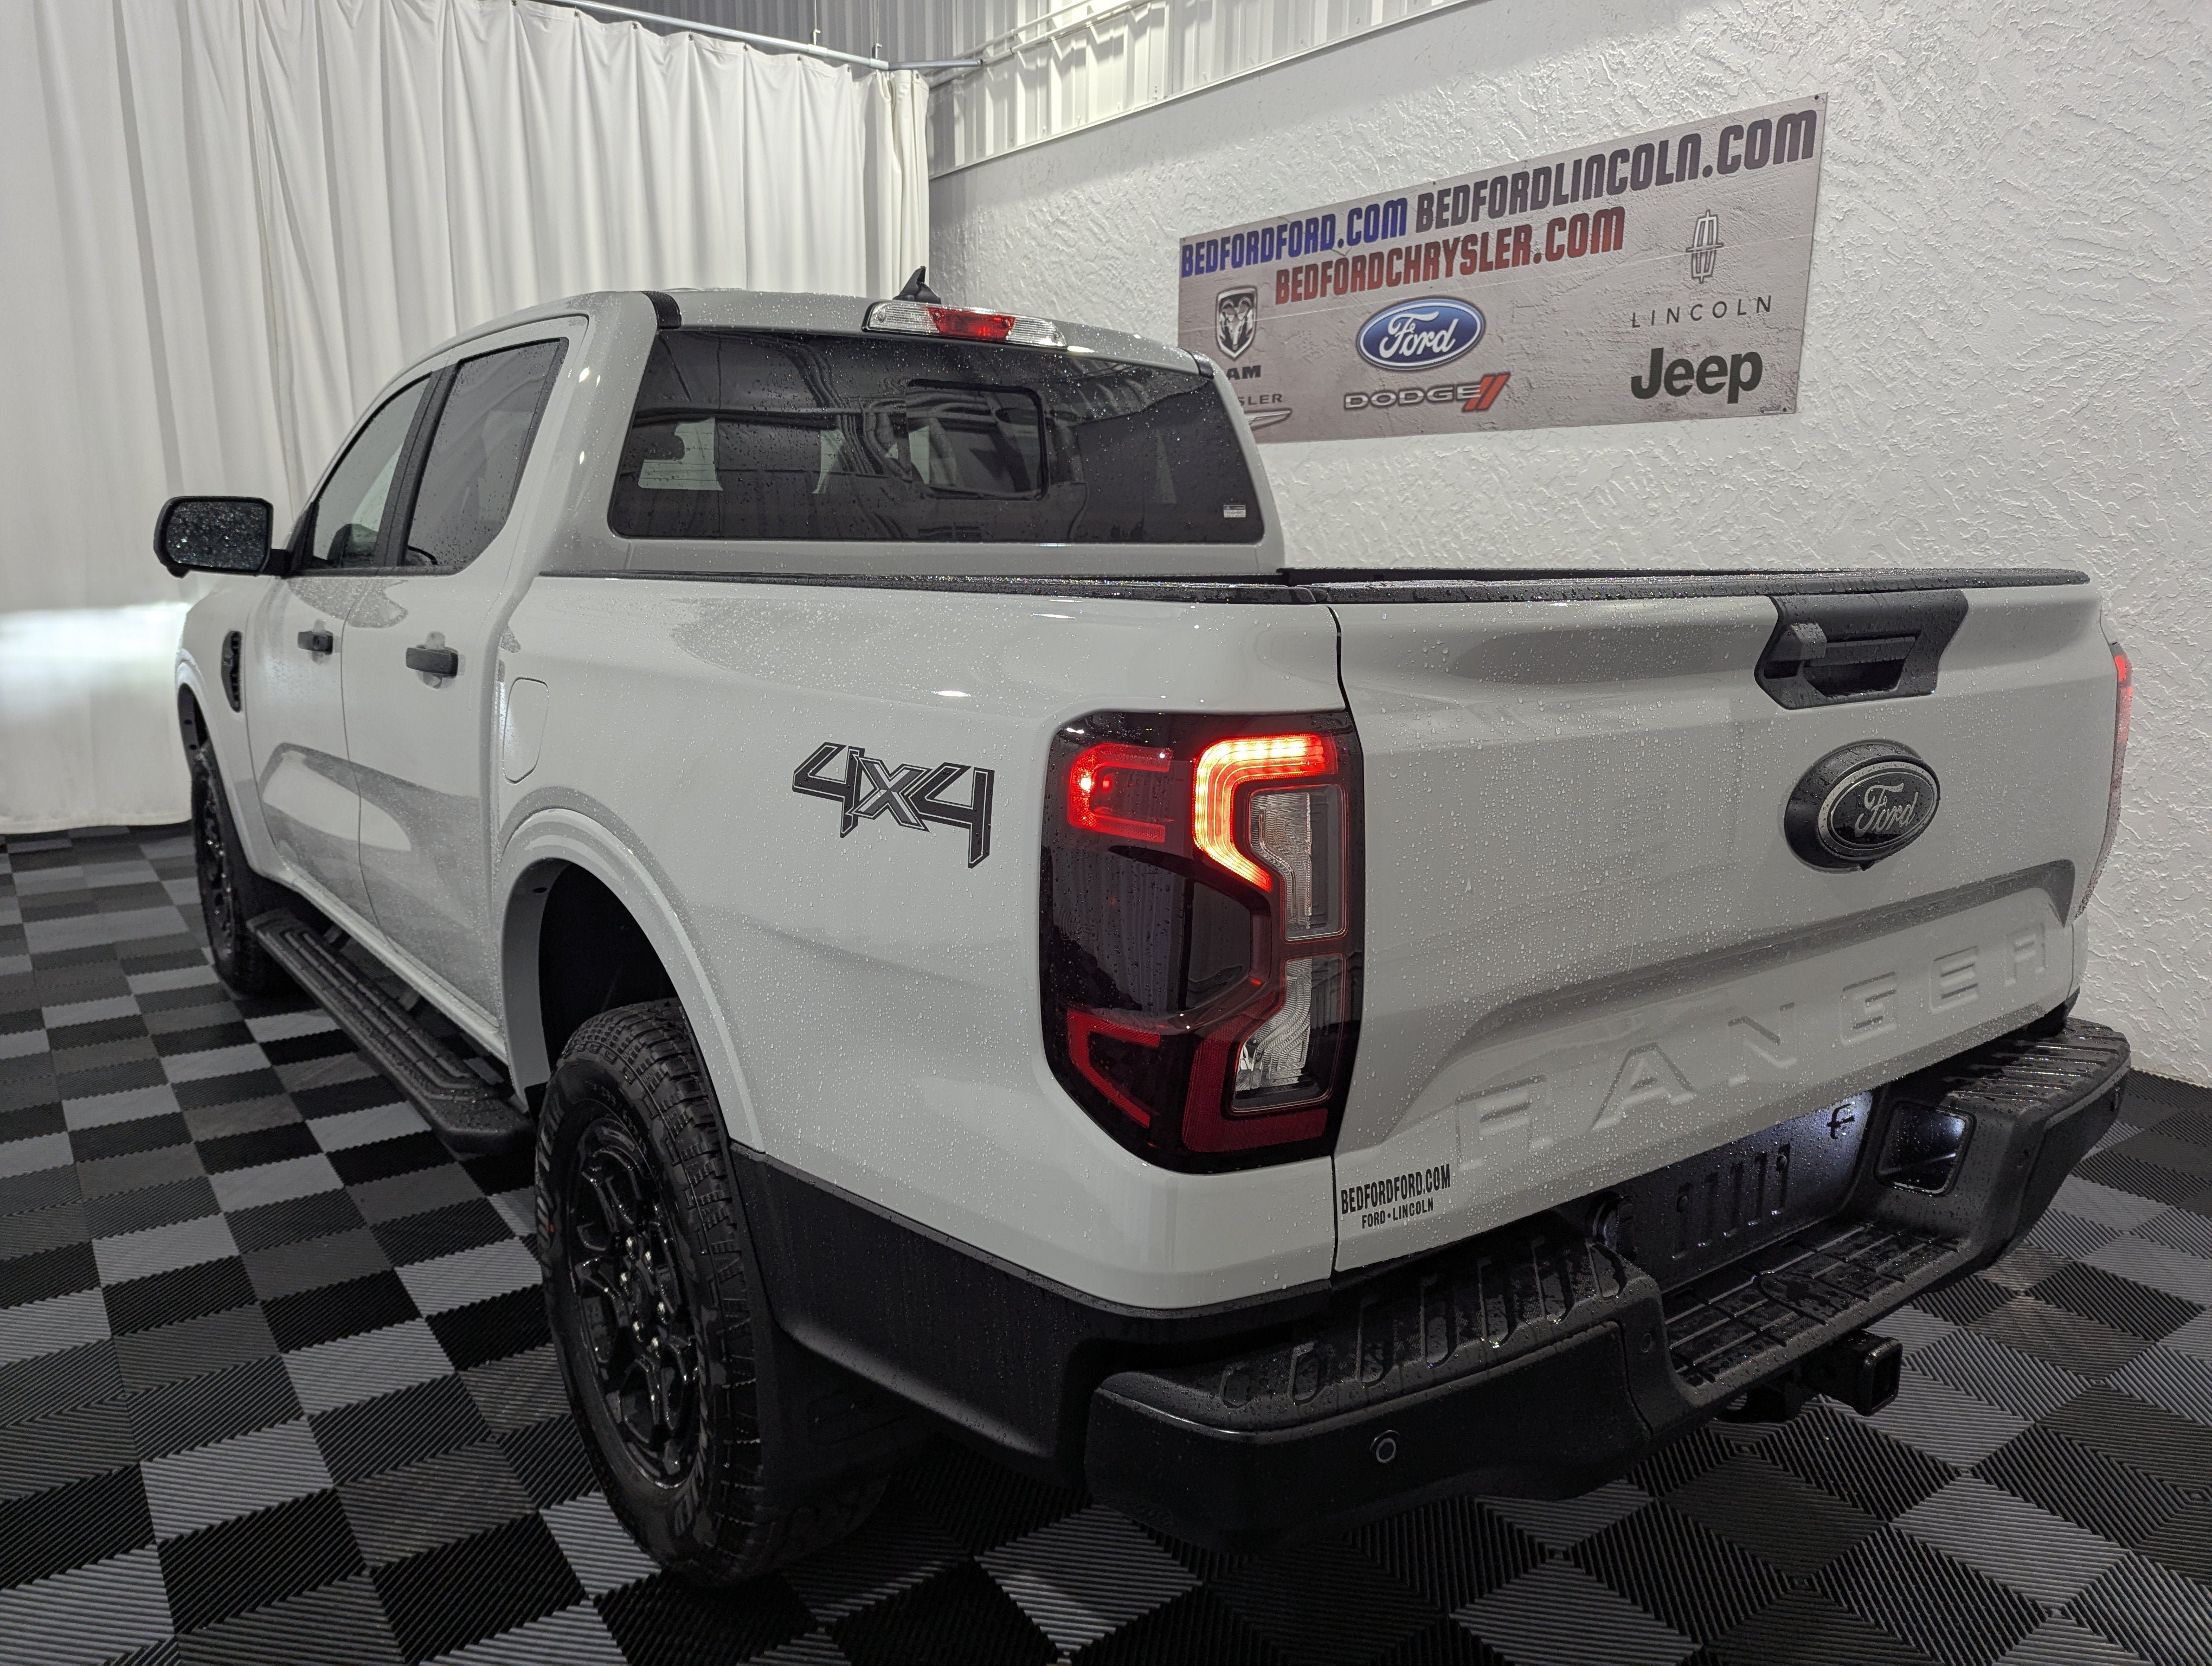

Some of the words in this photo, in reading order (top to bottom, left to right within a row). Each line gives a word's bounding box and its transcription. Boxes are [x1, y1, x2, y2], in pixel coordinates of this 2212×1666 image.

[1182, 198, 1407, 278] BEDFORDFORD.COM
[1416, 110, 1817, 233] BEDFORDLINCOLN.COM
[1275, 207, 1625, 304] BEDFORDCHRYSLER.COM
[1379, 311, 1459, 358] Ford
[1631, 296, 1772, 328] LINCOLN
[1226, 365, 1261, 380] AM
[1343, 383, 1482, 411] DODGE
[1631, 348, 1763, 403] Jeep
[1238, 394, 1283, 406] SLER
[1854, 783, 1919, 838] Ford
[1456, 922, 2045, 1170] RANGER
[1341, 1163, 1451, 1214] BEDFORDFORD.COM
